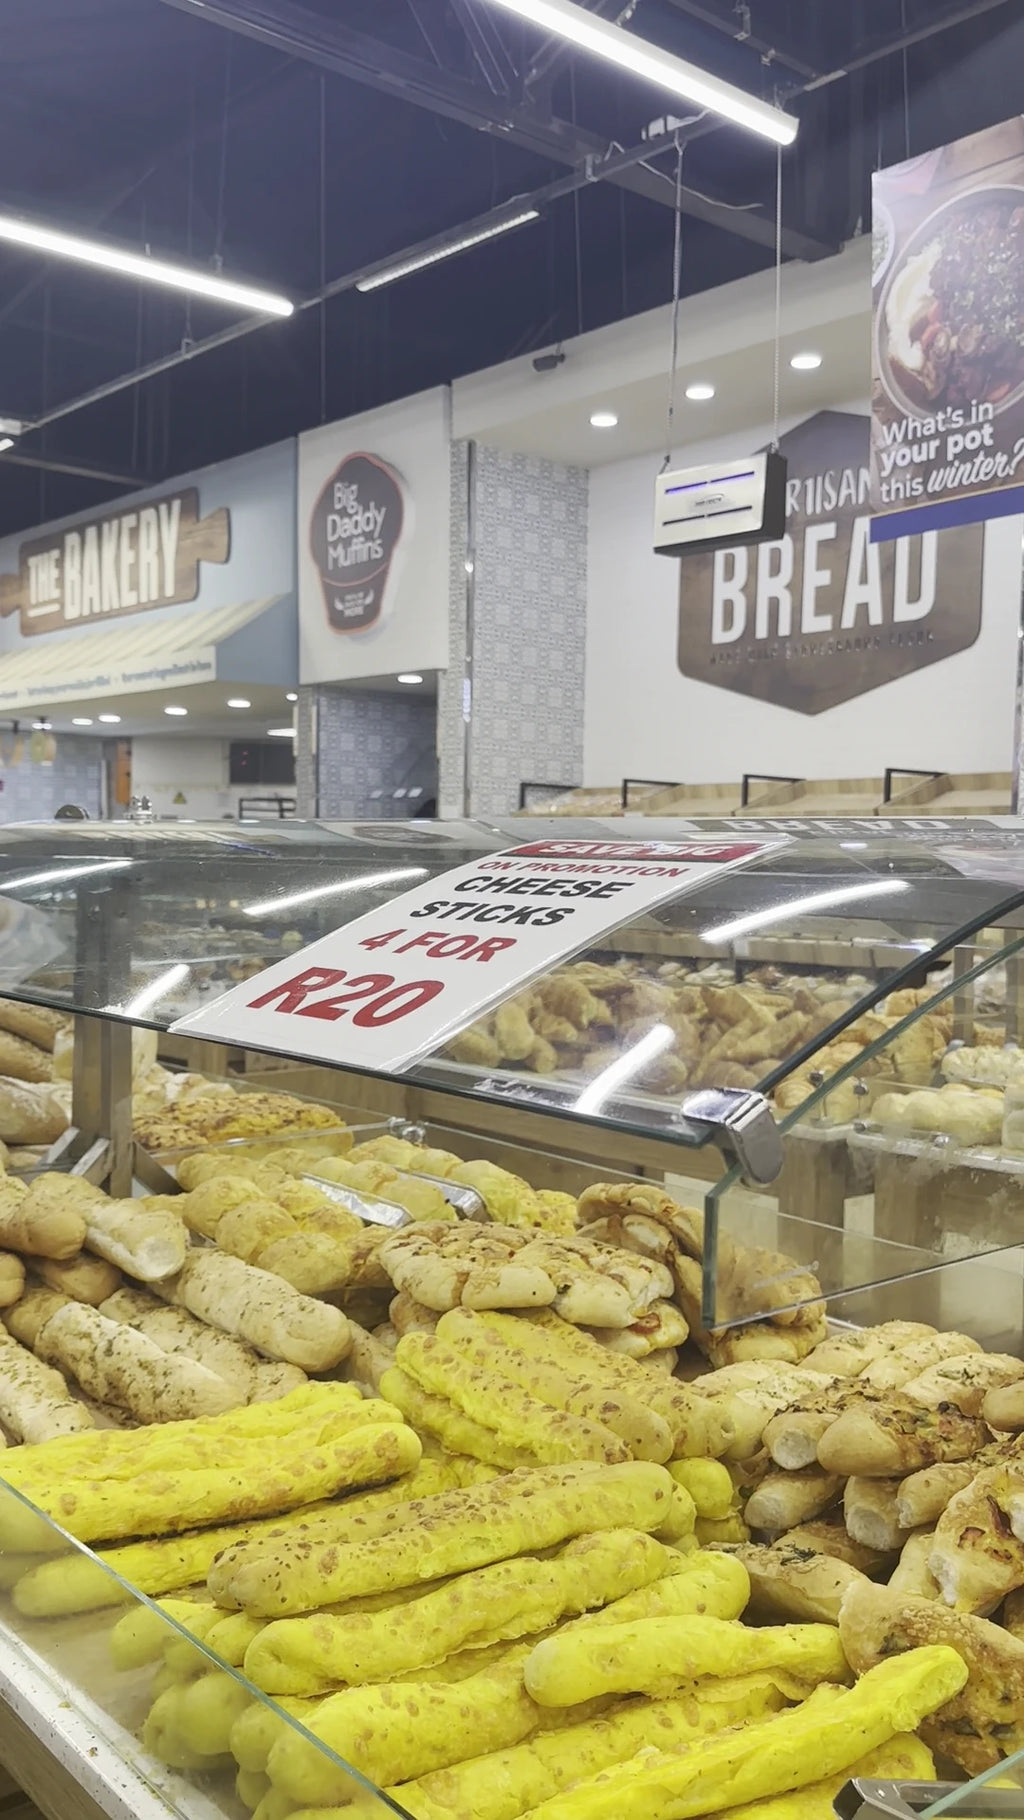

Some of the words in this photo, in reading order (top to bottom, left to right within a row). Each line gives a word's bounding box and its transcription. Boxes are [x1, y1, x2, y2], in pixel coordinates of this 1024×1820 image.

[882, 406, 964, 446] What's
[970, 399, 994, 424] in
[880, 438, 941, 477] your
[946, 423, 994, 461] pot
[880, 473, 924, 503] this
[926, 437, 1024, 494] winter?
[333, 481, 359, 515] Big
[326, 501, 387, 542] Daddy
[27, 548, 61, 605] THE
[63, 498, 182, 620] BAKERY
[327, 536, 385, 571] Muffins
[711, 516, 938, 645] BREAD
[477, 860, 512, 871] ON
[517, 861, 691, 877] PROMOTION
[539, 843, 641, 856] SAVE
[648, 844, 733, 857] BIG
[454, 876, 636, 899] CHEESE
[409, 900, 576, 926] STICKS
[357, 928, 408, 951] 4
[392, 931, 518, 962] FOR
[246, 966, 446, 1028] R20
